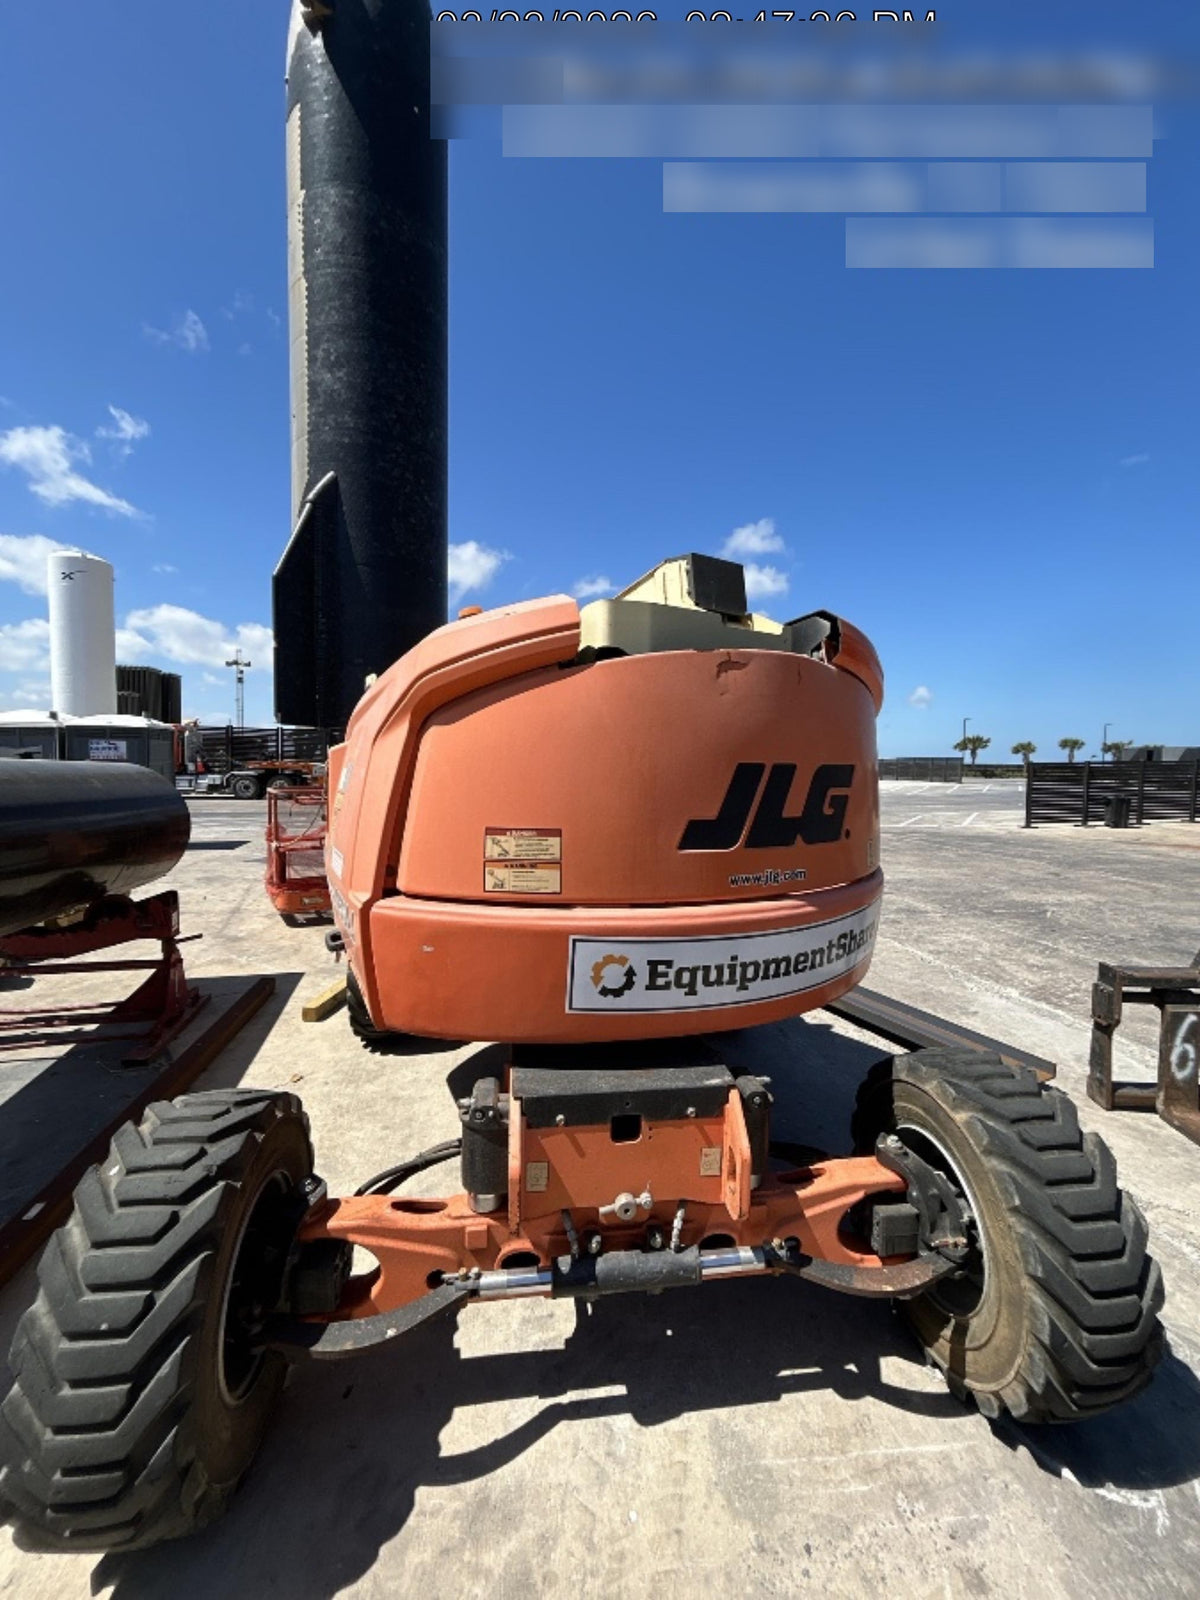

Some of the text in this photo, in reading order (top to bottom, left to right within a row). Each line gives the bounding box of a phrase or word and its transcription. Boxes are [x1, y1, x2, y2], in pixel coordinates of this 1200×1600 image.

[678, 762, 855, 851] JLG
[729, 869, 807, 887] www.jlg.com
[645, 920, 879, 996] EquipmentShar
[1170, 1013, 1198, 1080] 6
